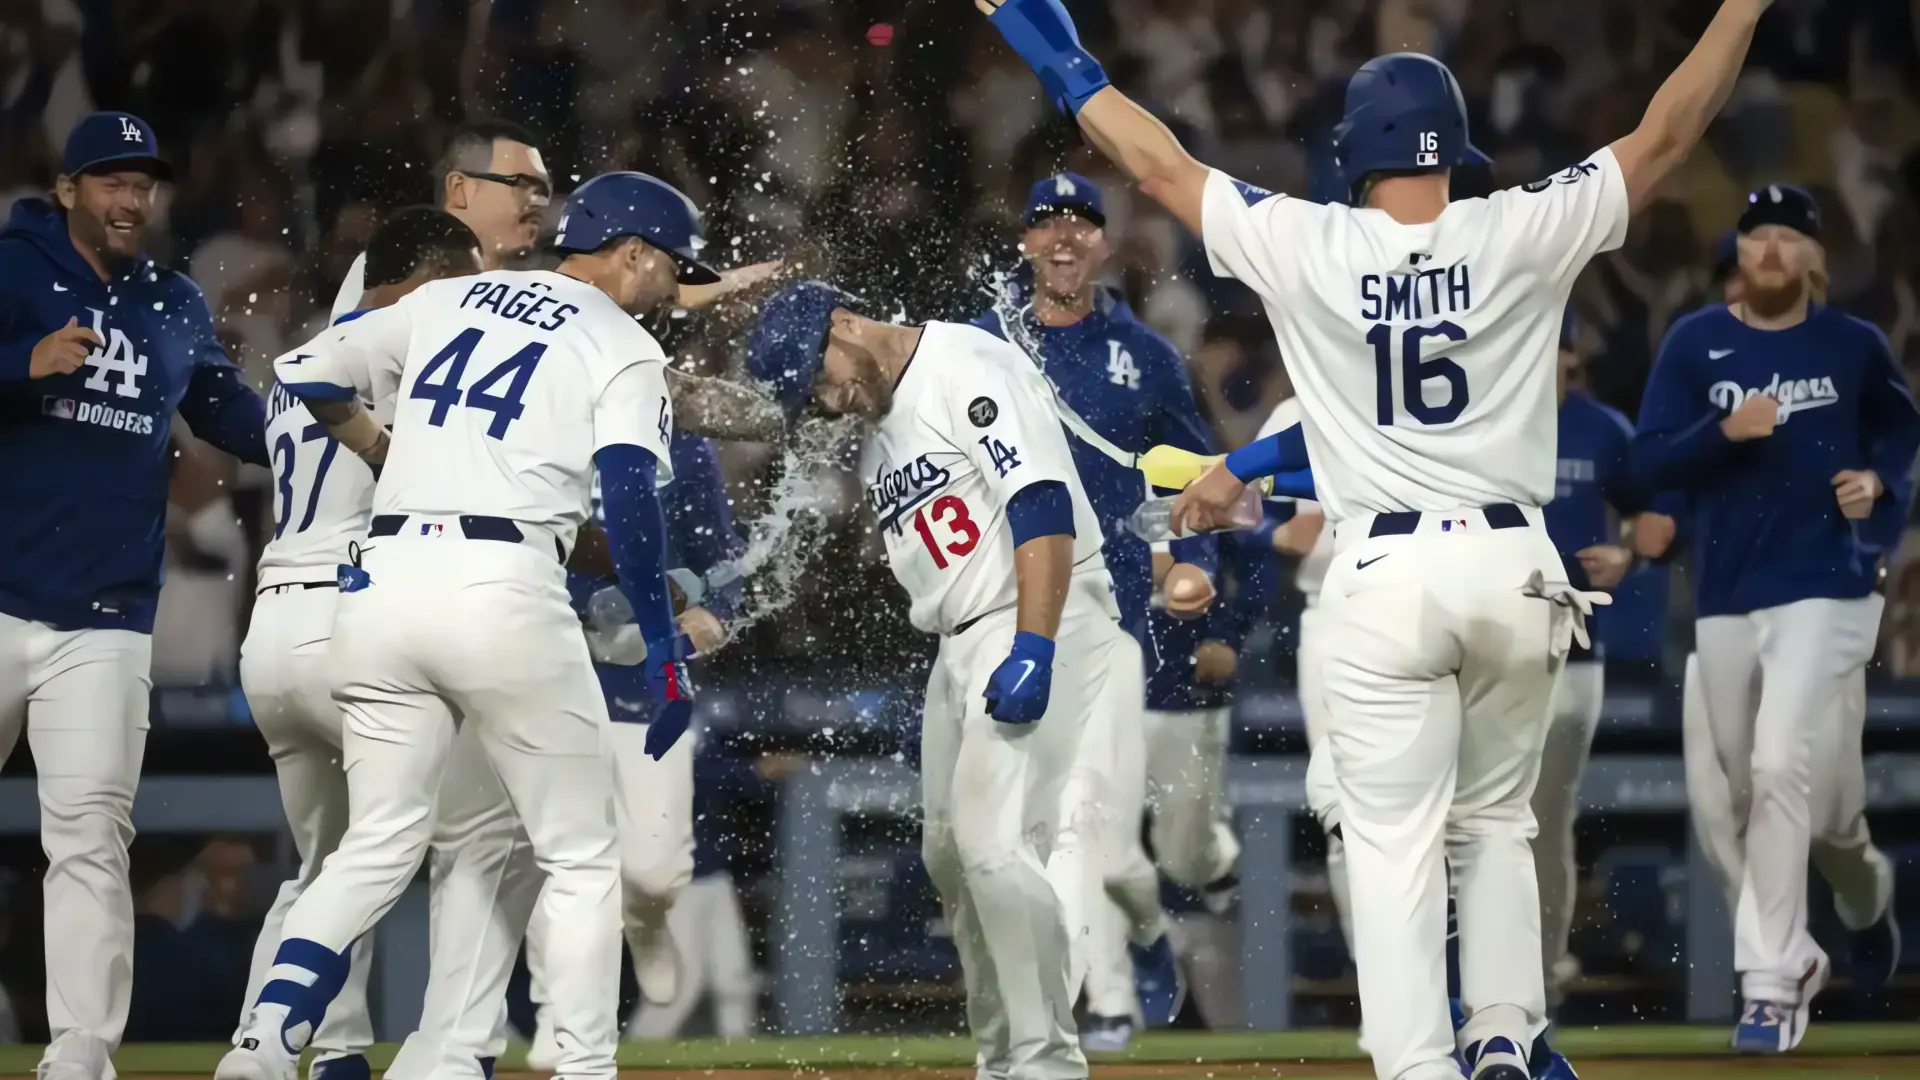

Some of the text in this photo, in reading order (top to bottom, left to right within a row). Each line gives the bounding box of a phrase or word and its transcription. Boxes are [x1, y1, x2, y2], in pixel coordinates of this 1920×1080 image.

[118, 117, 143, 142] LA
[1419, 131, 1439, 151] 16
[460, 282, 580, 331] PAGES
[1361, 264, 1471, 322] SMITH
[84, 306, 148, 399] LA
[1105, 339, 1142, 391] LA
[1366, 320, 1470, 426] 16
[410, 327, 548, 441] 44
[76, 401, 154, 435] DODGERS
[273, 421, 340, 541] 37
[978, 434, 1022, 479] LA
[914, 495, 981, 570] 13
